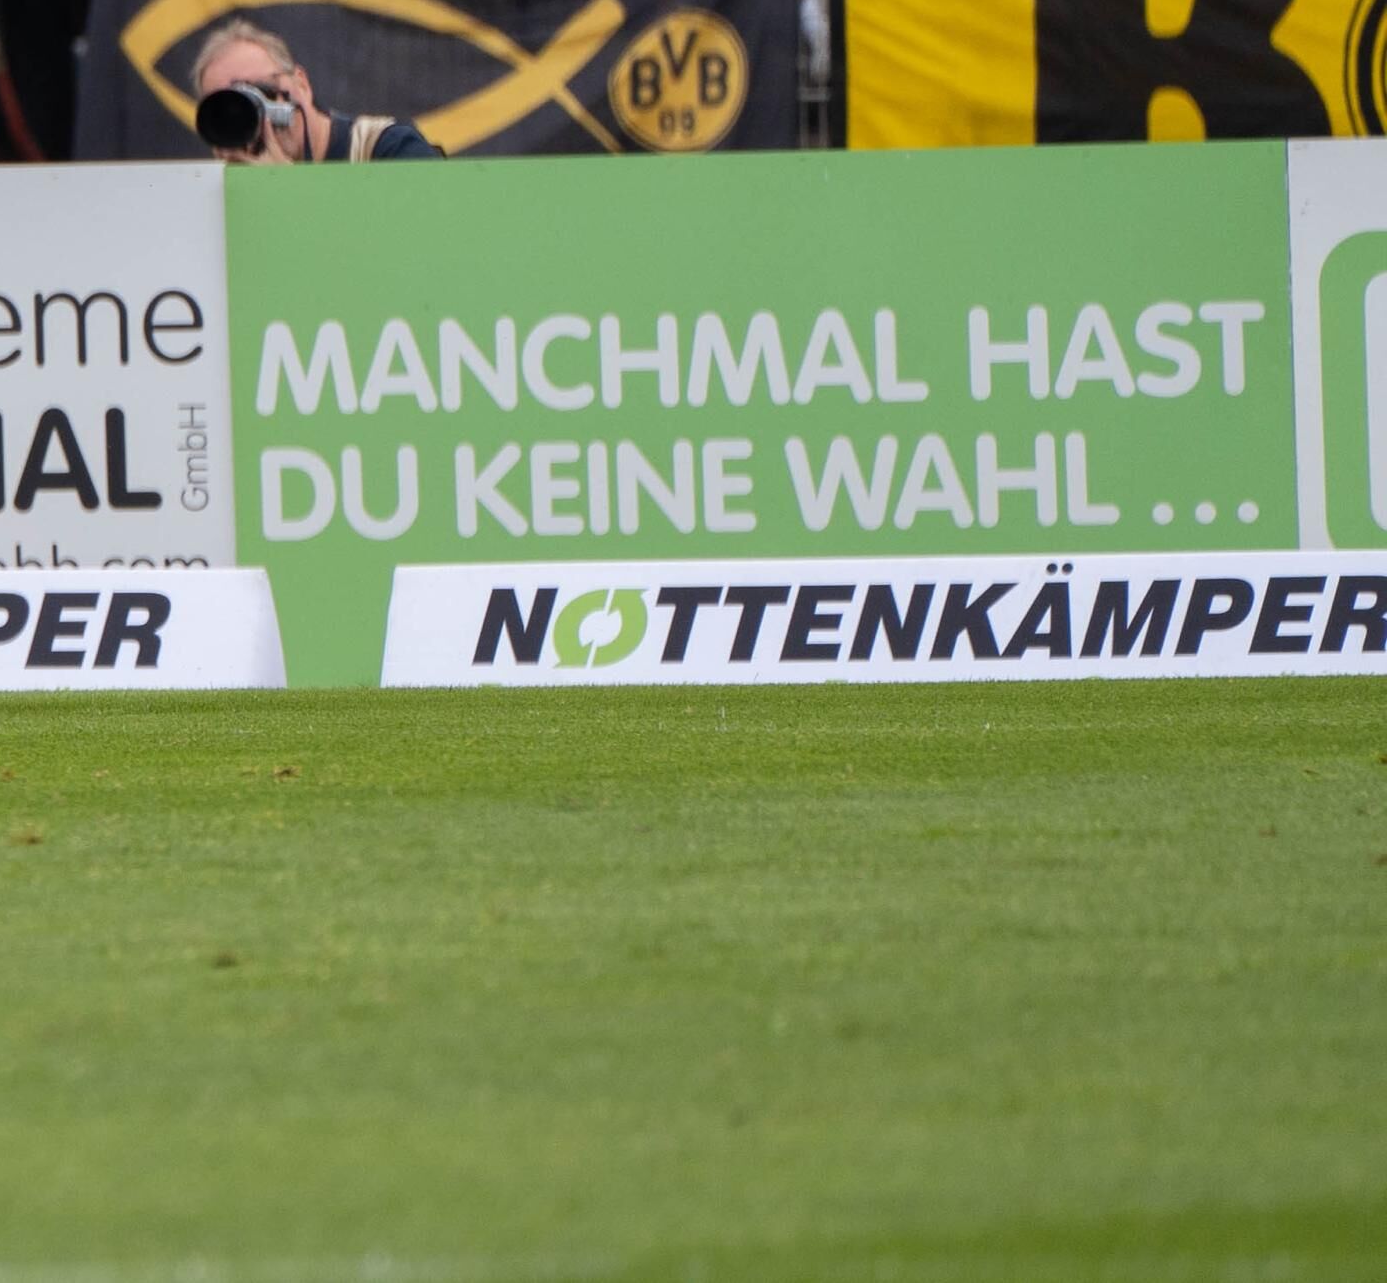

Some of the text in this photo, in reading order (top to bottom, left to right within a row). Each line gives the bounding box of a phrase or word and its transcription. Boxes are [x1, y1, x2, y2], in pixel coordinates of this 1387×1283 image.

[631, 29, 728, 109] BVB
[256, 301, 1266, 416] MANCHMAL HAST
[178, 402, 208, 512] GmbH
[260, 441, 420, 541] DU
[454, 437, 757, 537] KEINE
[784, 431, 1120, 532] WAHL
